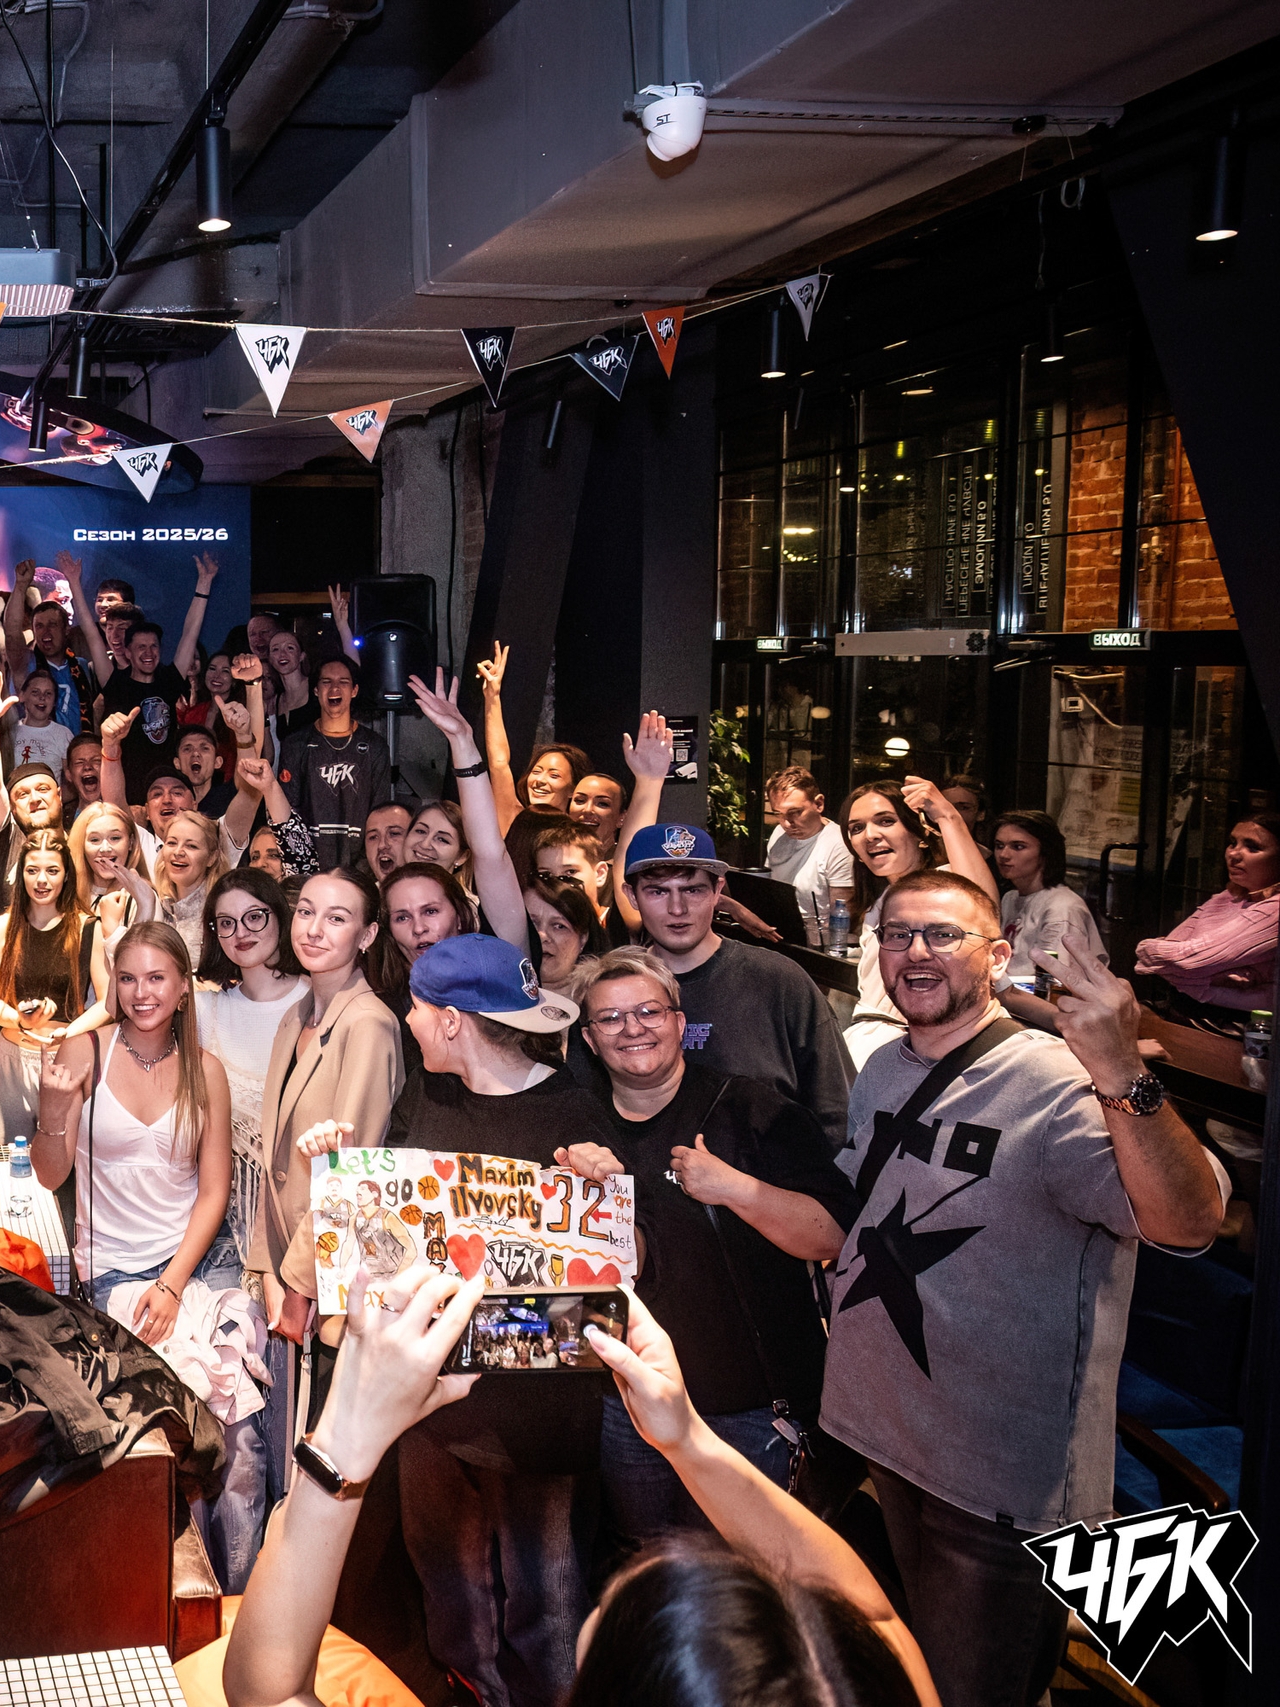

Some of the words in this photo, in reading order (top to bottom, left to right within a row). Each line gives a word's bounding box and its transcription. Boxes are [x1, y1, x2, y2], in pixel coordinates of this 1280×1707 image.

[142, 528, 229, 541] 2025/26
[757, 638, 783, 650] ВЫХОД
[1093, 632, 1141, 647] ВЫХОД
[319, 763, 355, 788] ЧБК
[457, 1154, 535, 1187] Maxim
[385, 1178, 413, 1206] go
[547, 1174, 609, 1241] 32
[614, 1195, 632, 1209] are
[615, 1212, 632, 1226] the
[608, 1230, 632, 1249] best
